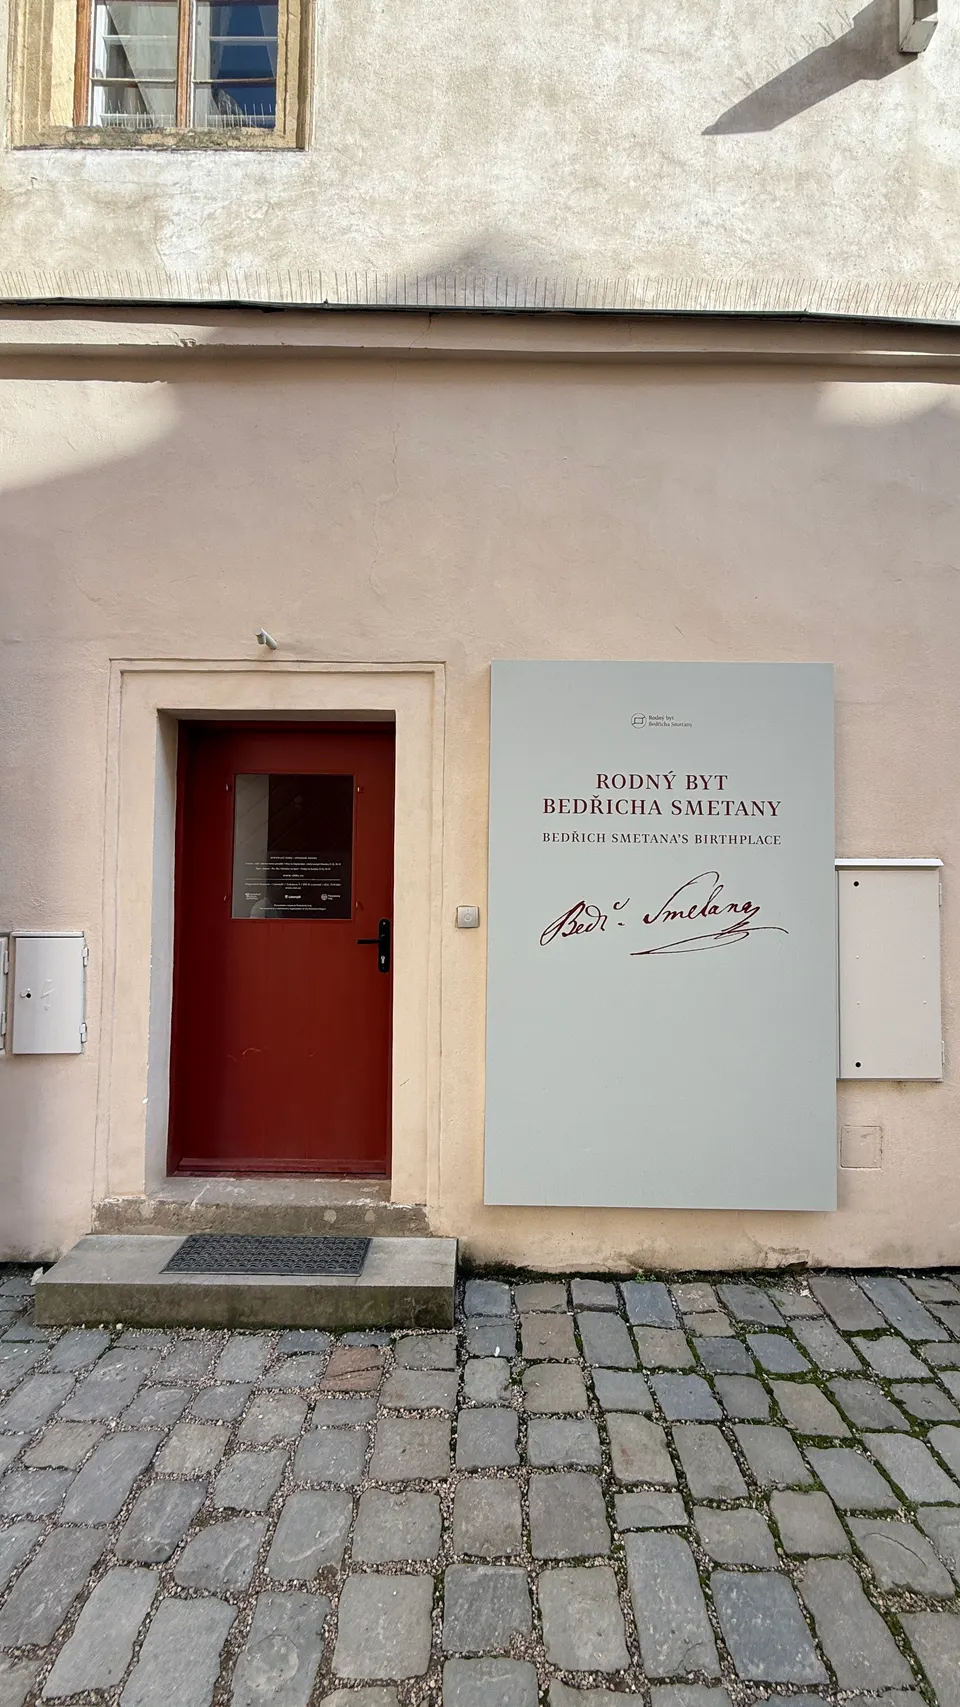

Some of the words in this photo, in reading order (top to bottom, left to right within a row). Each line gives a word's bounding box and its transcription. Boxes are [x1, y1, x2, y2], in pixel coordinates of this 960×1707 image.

[595, 770, 676, 791] RODNÝ
[684, 774, 729, 791] BYT
[542, 795, 663, 816] BEDŘICHA
[671, 799, 782, 817] SMETANY
[542, 831, 606, 843] BEDŘICH
[694, 834, 782, 846] BIRTHPLACE
